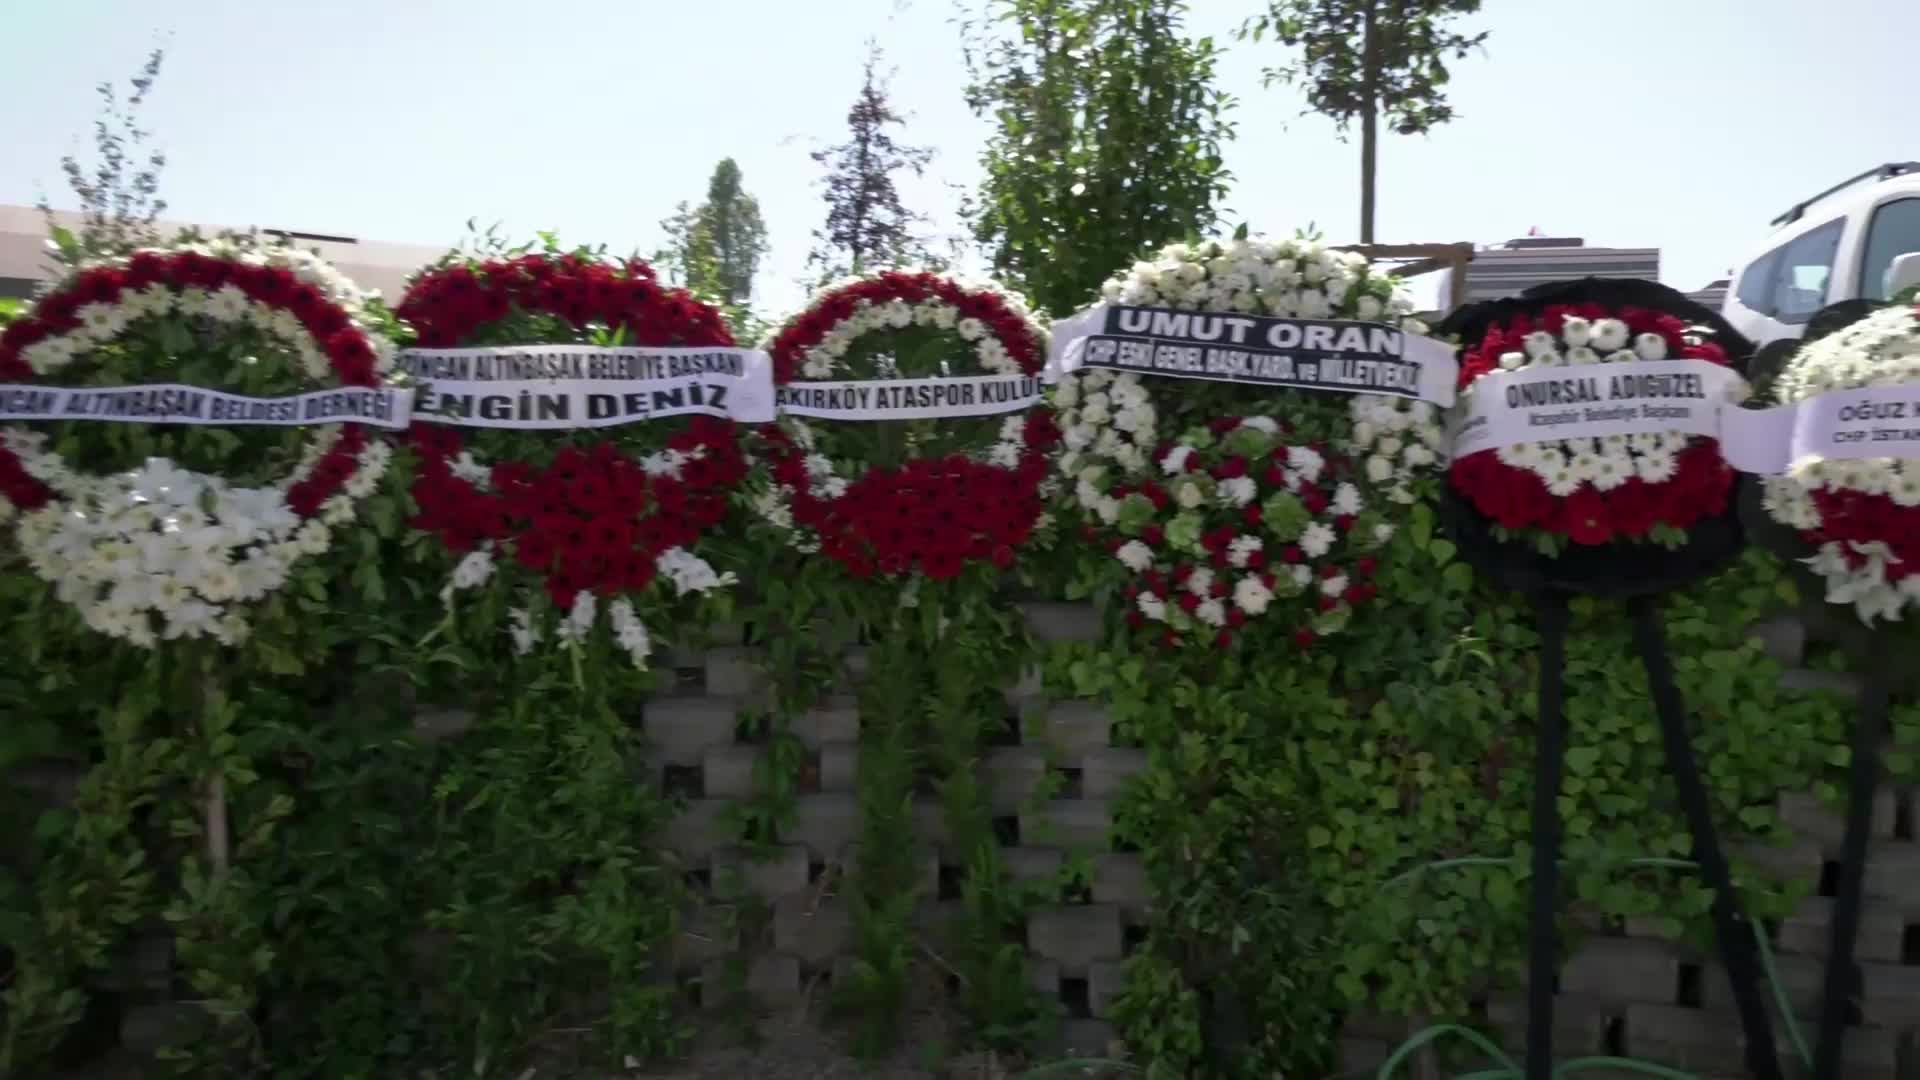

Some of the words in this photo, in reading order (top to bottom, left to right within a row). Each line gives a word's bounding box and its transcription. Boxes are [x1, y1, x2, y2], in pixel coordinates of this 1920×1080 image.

[1118, 309, 1256, 343] UMUT
[1266, 322, 1400, 355] ORAN
[474, 353, 584, 384] ALTINBAŞAK
[588, 352, 664, 380] BELEDİYE
[1155, 345, 1204, 373] GENEL
[414, 388, 569, 420] ENGİN
[587, 381, 728, 420] DENİZ
[774, 384, 870, 410] AKIRKÖY
[876, 384, 974, 409] ATASPOR
[1506, 377, 1601, 409] ONURSAL
[1838, 400, 1905, 421] OĞUZ
